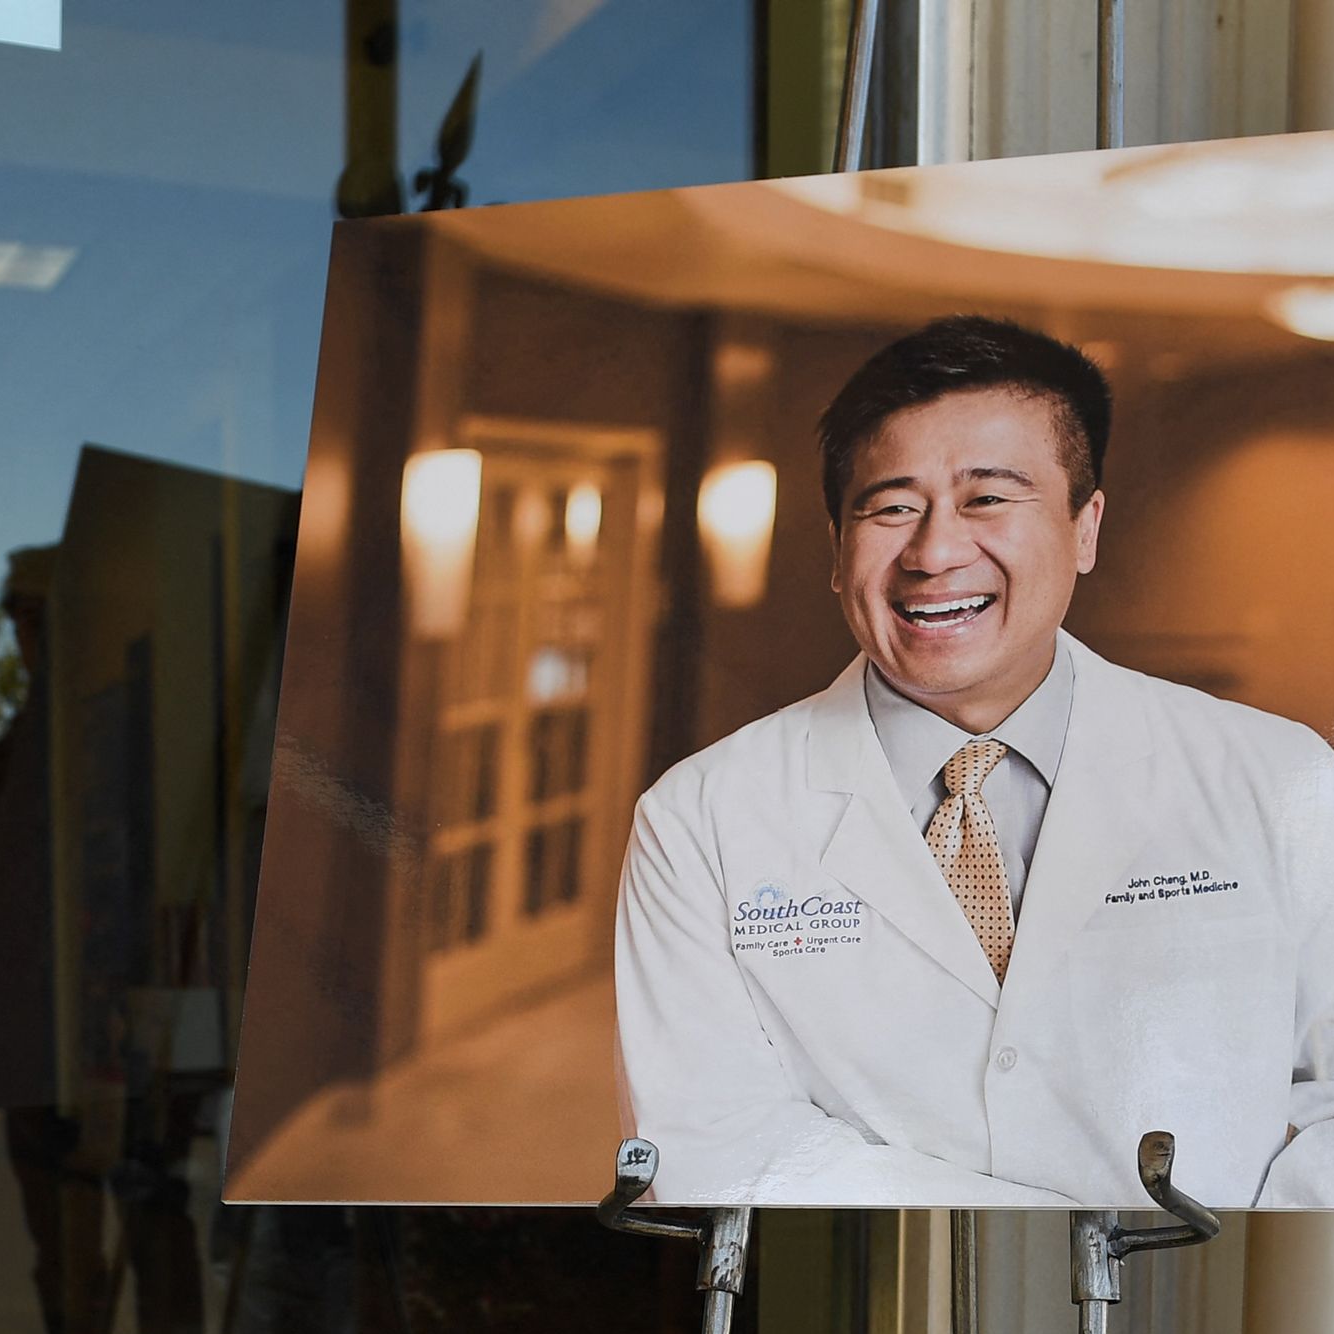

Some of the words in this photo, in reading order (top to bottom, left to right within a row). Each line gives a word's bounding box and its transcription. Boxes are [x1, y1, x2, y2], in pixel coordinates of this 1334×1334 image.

[1128, 878, 1151, 889] John
[1190, 870, 1213, 882] M.D.
[1105, 892, 1135, 904] Family
[1138, 890, 1155, 900] and
[1158, 886, 1190, 900] Sports
[1192, 881, 1238, 895] Medicine
[734, 921, 803, 936] MEDICAL
[809, 918, 860, 929] GROUP
[735, 941, 766, 951] Family
[767, 940, 789, 949] Care
[806, 936, 838, 946] Urgent
[840, 936, 861, 944] Care
[772, 948, 803, 957] Sports
[805, 946, 826, 954] Care
